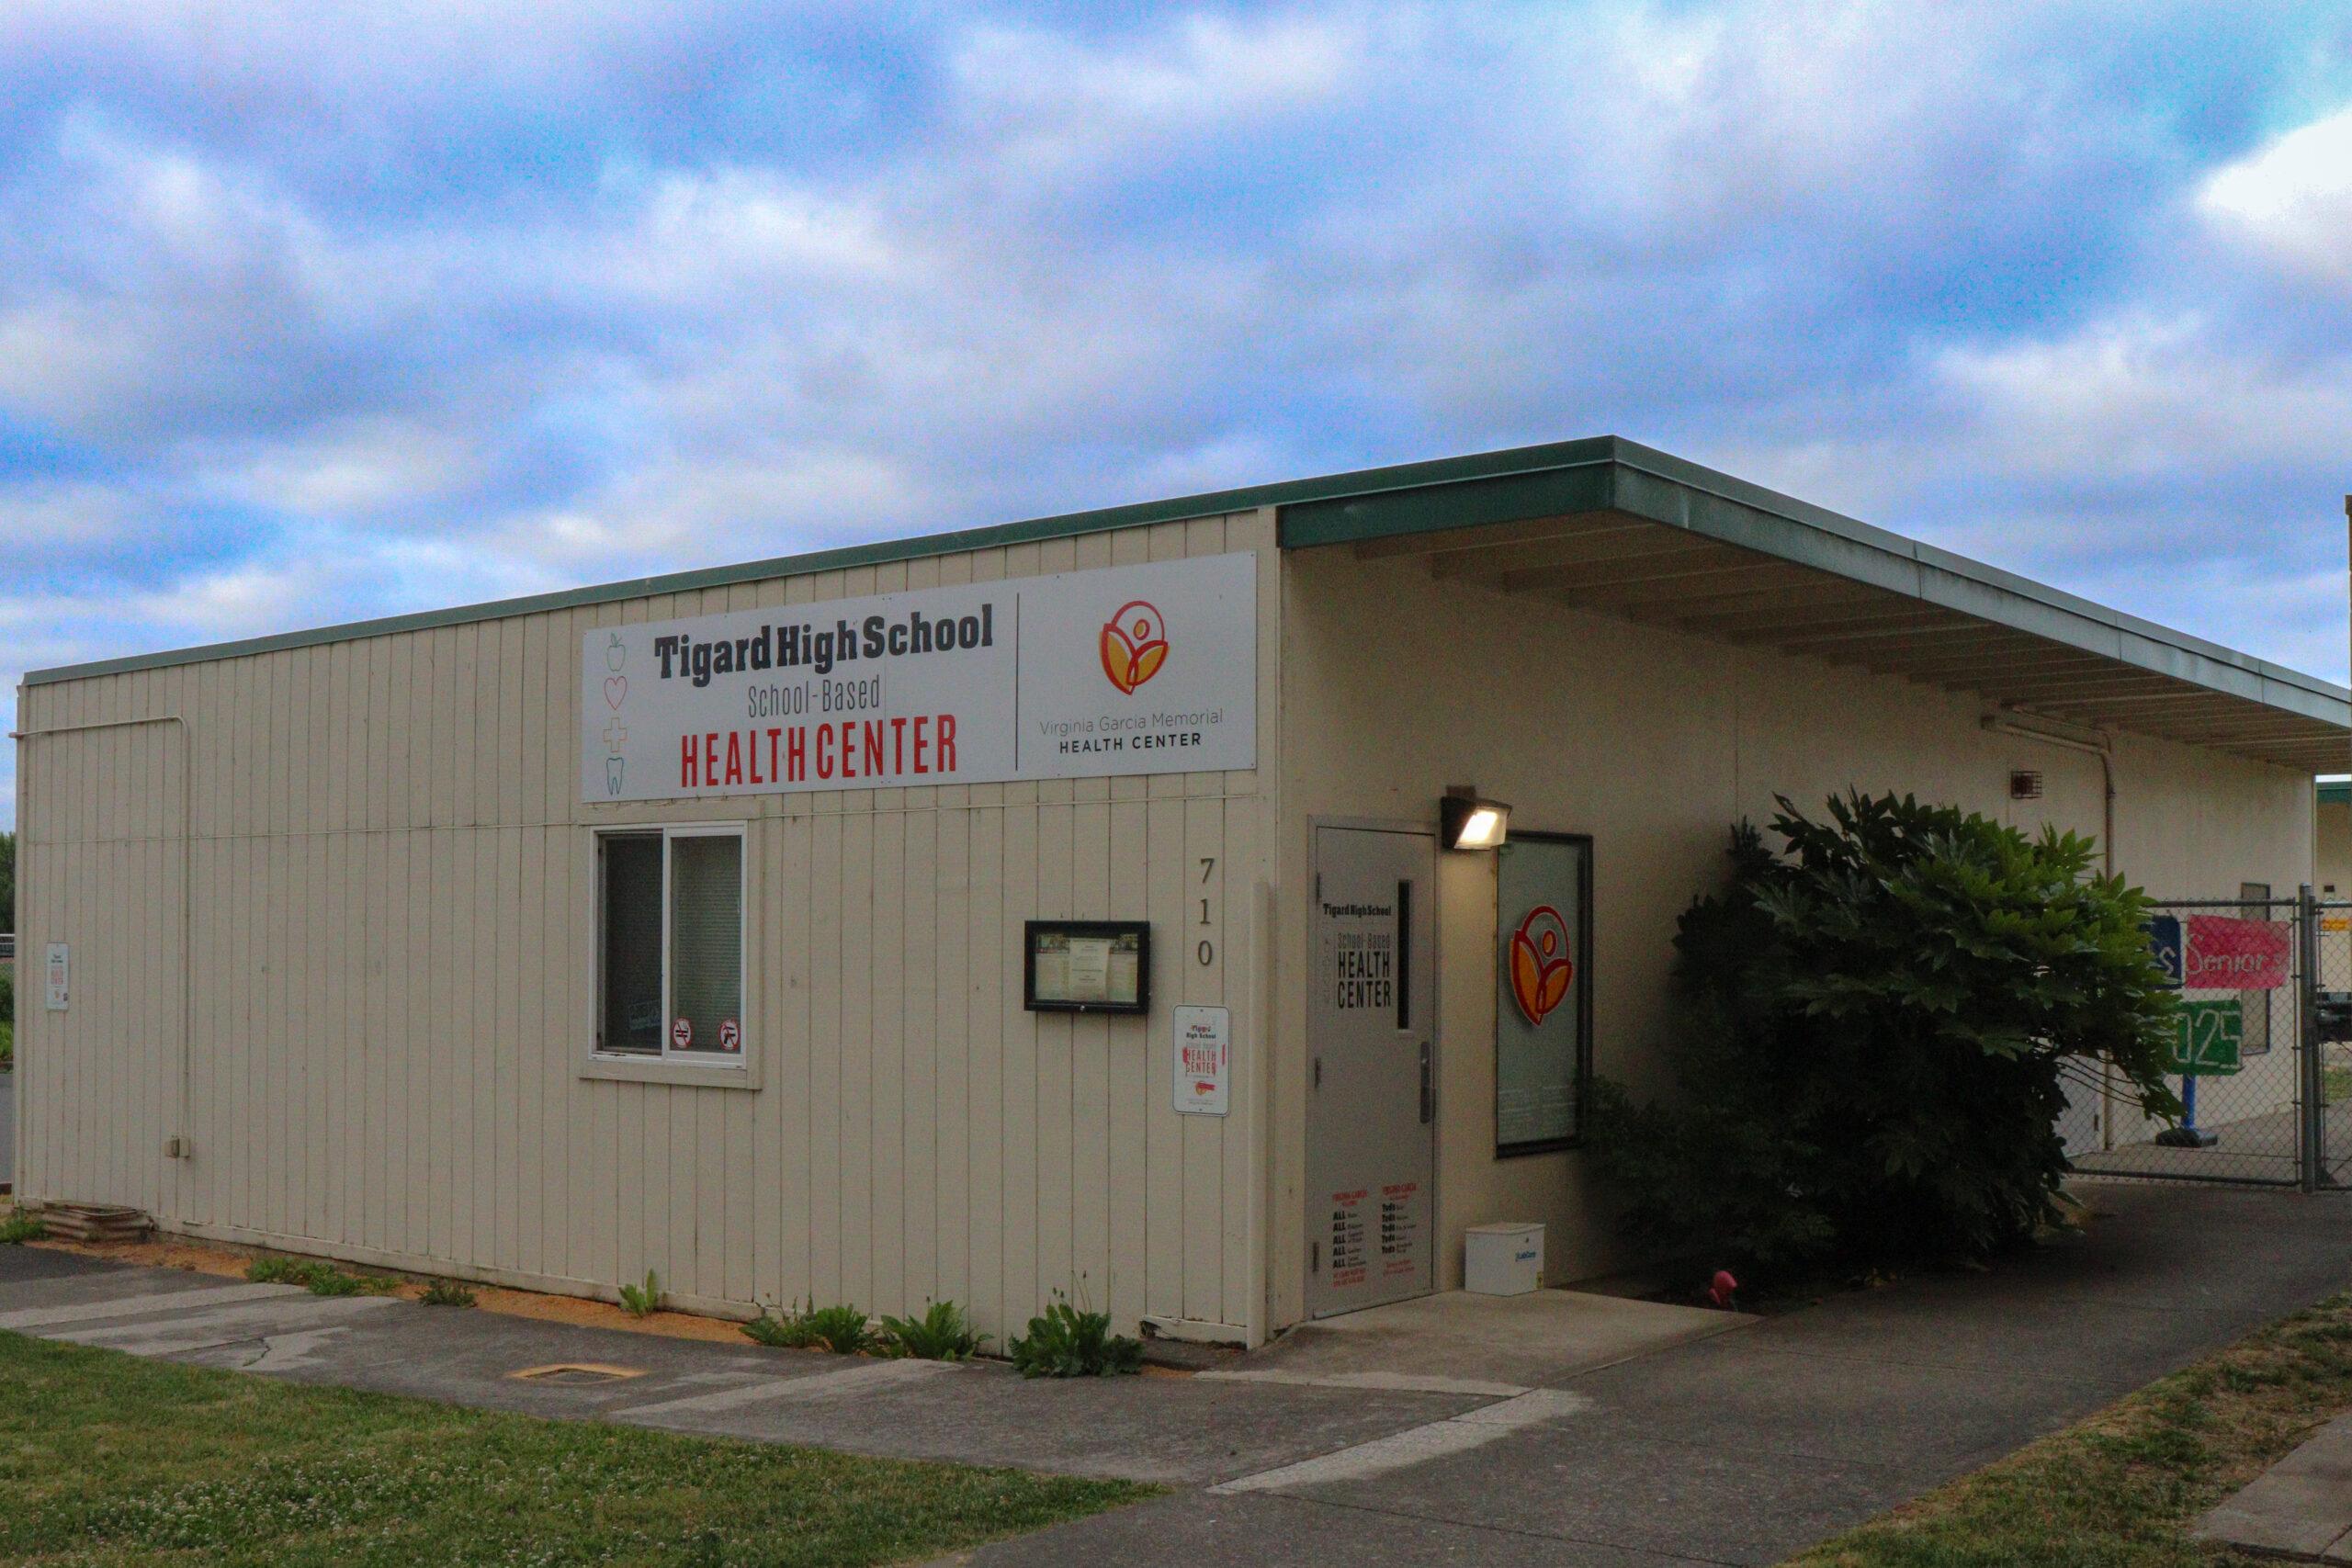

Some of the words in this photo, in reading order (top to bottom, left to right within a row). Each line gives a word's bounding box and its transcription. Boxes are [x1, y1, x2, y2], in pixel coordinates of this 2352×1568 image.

[654, 625, 771, 687] Tigard
[777, 619, 857, 674] High
[863, 603, 993, 659] School
[748, 674, 880, 718] School-Based
[1039, 719, 1093, 737] Virginia
[1099, 715, 1147, 731] Garcia
[1152, 708, 1223, 728] Memorial
[681, 726, 806, 788] HEALTH
[816, 714, 956, 780] CENTER
[1059, 738, 1123, 754] HEALTH
[1132, 732, 1202, 750] CENTER
[1338, 951, 1390, 979] HEALTH
[1338, 980, 1391, 1009] CENTER
[1185, 1049, 1216, 1062] HEALTH
